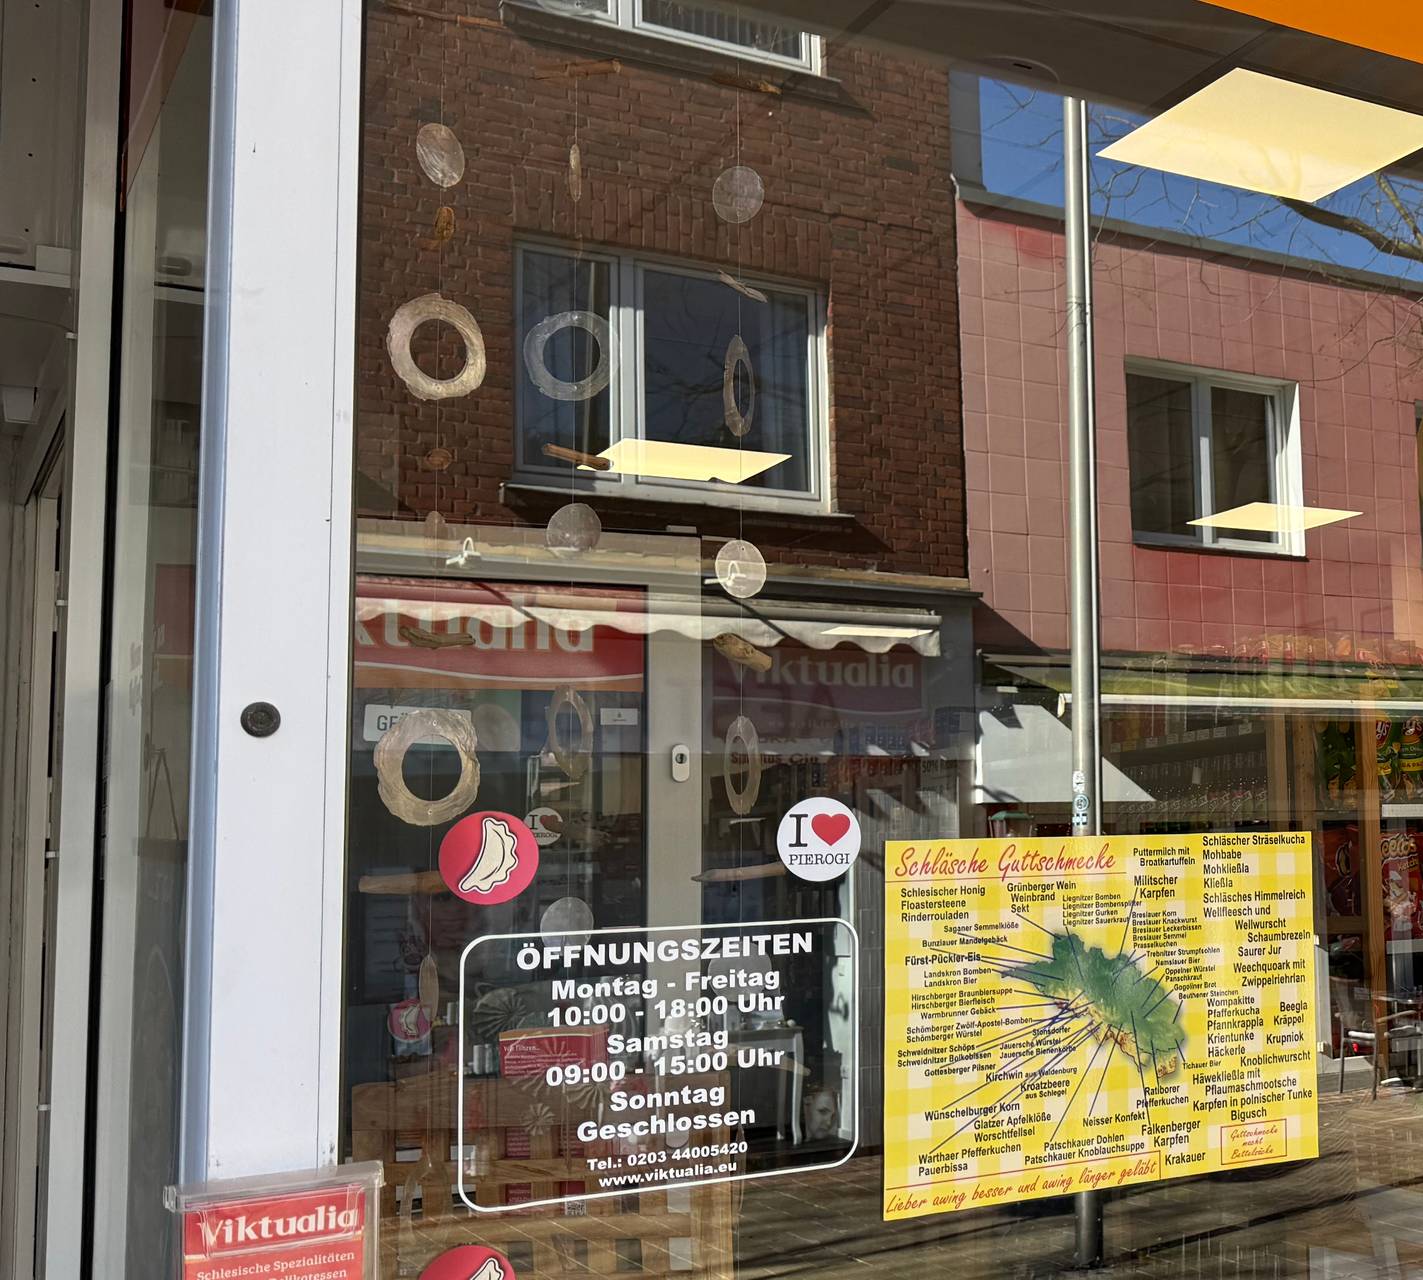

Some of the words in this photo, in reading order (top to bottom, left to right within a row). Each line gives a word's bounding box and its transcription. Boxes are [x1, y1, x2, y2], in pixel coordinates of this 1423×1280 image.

[789, 814, 808, 847] I
[1203, 835, 1250, 846] Schläscher
[1252, 834, 1305, 845] Sträselkucha
[1133, 847, 1177, 857] Puttermilch
[1178, 847, 1190, 856] mit
[1203, 850, 1242, 859] Mohbabe
[788, 852, 851, 868] PIEROGI
[895, 846, 989, 877] Schläsche
[998, 842, 1116, 882] Guttschmecke
[1140, 857, 1195, 867] Broatkartuffeln
[1203, 864, 1249, 874] Mohkließla
[1007, 882, 1054, 892] Grünberger
[1056, 881, 1076, 890] Wein
[1134, 875, 1178, 886] Militscher
[1204, 878, 1233, 888] Kließla
[901, 888, 957, 898] Schlesischer
[960, 885, 985, 896] Honig
[1011, 892, 1055, 902] Weinbrand
[1140, 888, 1175, 900] Karpfen
[1203, 892, 1252, 903] Schläsches
[1254, 889, 1306, 901] Himmelreich
[901, 900, 966, 910] Floastersteene
[1011, 904, 1030, 913] Sekt
[1204, 906, 1253, 918] Wellfleesch
[1255, 905, 1271, 915] und
[901, 911, 969, 922] Rinderrouladen
[1235, 919, 1286, 930] Wellwurscht
[1248, 930, 1311, 943] Schaumbrezeln
[516, 932, 813, 970] ÖFFNUNGSZEITEN
[1238, 946, 1265, 957] Saurer
[1267, 945, 1282, 955] Jur
[924, 969, 961, 978] Landskron
[963, 967, 991, 976] Bomben
[1234, 961, 1290, 974] Weechquoark
[1293, 959, 1306, 969] mit
[552, 977, 658, 1000] Montag
[686, 969, 780, 995] Freitag
[924, 979, 962, 988] Landskron
[964, 977, 977, 985] Bier
[548, 1003, 626, 1027] 10:00
[654, 996, 728, 1020] 18:00
[737, 993, 785, 1013] Uhr
[1280, 1001, 1308, 1013] Beegla
[1208, 1006, 1260, 1018] Pfafferkucha
[1273, 1015, 1304, 1026] Kräppel
[1207, 1017, 1264, 1030] Pfannkrappla
[607, 1029, 729, 1054] Samstag
[1207, 1031, 1255, 1044] Krientunke
[1266, 1031, 1304, 1045] Krupniok
[1208, 1045, 1246, 1058] Häckerle
[1240, 1050, 1311, 1067] Knoblichwurscht
[546, 1062, 626, 1087] 09:00
[653, 1052, 728, 1077] 15:00
[737, 1048, 785, 1068] Uhr
[985, 1071, 1023, 1082] Kirchwin
[1193, 1069, 1245, 1084] Häwekließla
[1247, 1068, 1261, 1079] mit
[1021, 1079, 1070, 1092] Kroatzbeere
[1205, 1077, 1297, 1096] Pflaumaschmootsche
[610, 1085, 725, 1111] Sonntag
[1136, 1095, 1189, 1109] Pfefferkuchen
[1193, 1099, 1228, 1112] Karpfen
[1230, 1099, 1238, 1108] in
[1240, 1093, 1285, 1108] polnischer
[1288, 1089, 1313, 1101] Tunke
[924, 1105, 997, 1121] Wünschelburger
[999, 1102, 1020, 1112] Korn
[1231, 1107, 1267, 1122] Bigusch
[577, 1108, 756, 1142] Geschlossen
[974, 1118, 1004, 1130] Glatzer
[1007, 1112, 1051, 1127] Apfelklöße
[1082, 1115, 1113, 1127] Neisser
[1115, 1111, 1146, 1122] Konfekt
[1141, 1120, 1201, 1136] Falkenberger
[1044, 1138, 1094, 1151] Patschkauer
[1097, 1133, 1125, 1144] Dohlen
[1153, 1134, 1189, 1148] Karpfen
[587, 1157, 623, 1172] Tel.:
[627, 1151, 667, 1167] 0203
[672, 1141, 748, 1161] 44005420
[919, 1149, 958, 1165] Warthaer
[961, 1143, 1021, 1159] Pfefferkuchen
[1025, 1150, 1076, 1165] Patschkauer
[1165, 1152, 1206, 1166] Krakauer
[599, 1161, 737, 1188] www.viktualia.eu
[919, 1162, 968, 1176] Pauerbissa
[886, 1194, 928, 1214] Lieber
[972, 1184, 1013, 1201] besser
[1018, 1175, 1040, 1193] und
[1078, 1166, 1116, 1189] länger
[1118, 1159, 1157, 1183] geläbt
[197, 1205, 358, 1247] Viktualia
[196, 1264, 271, 1280] Schlesische
[273, 1252, 355, 1271] Spezialitäten
